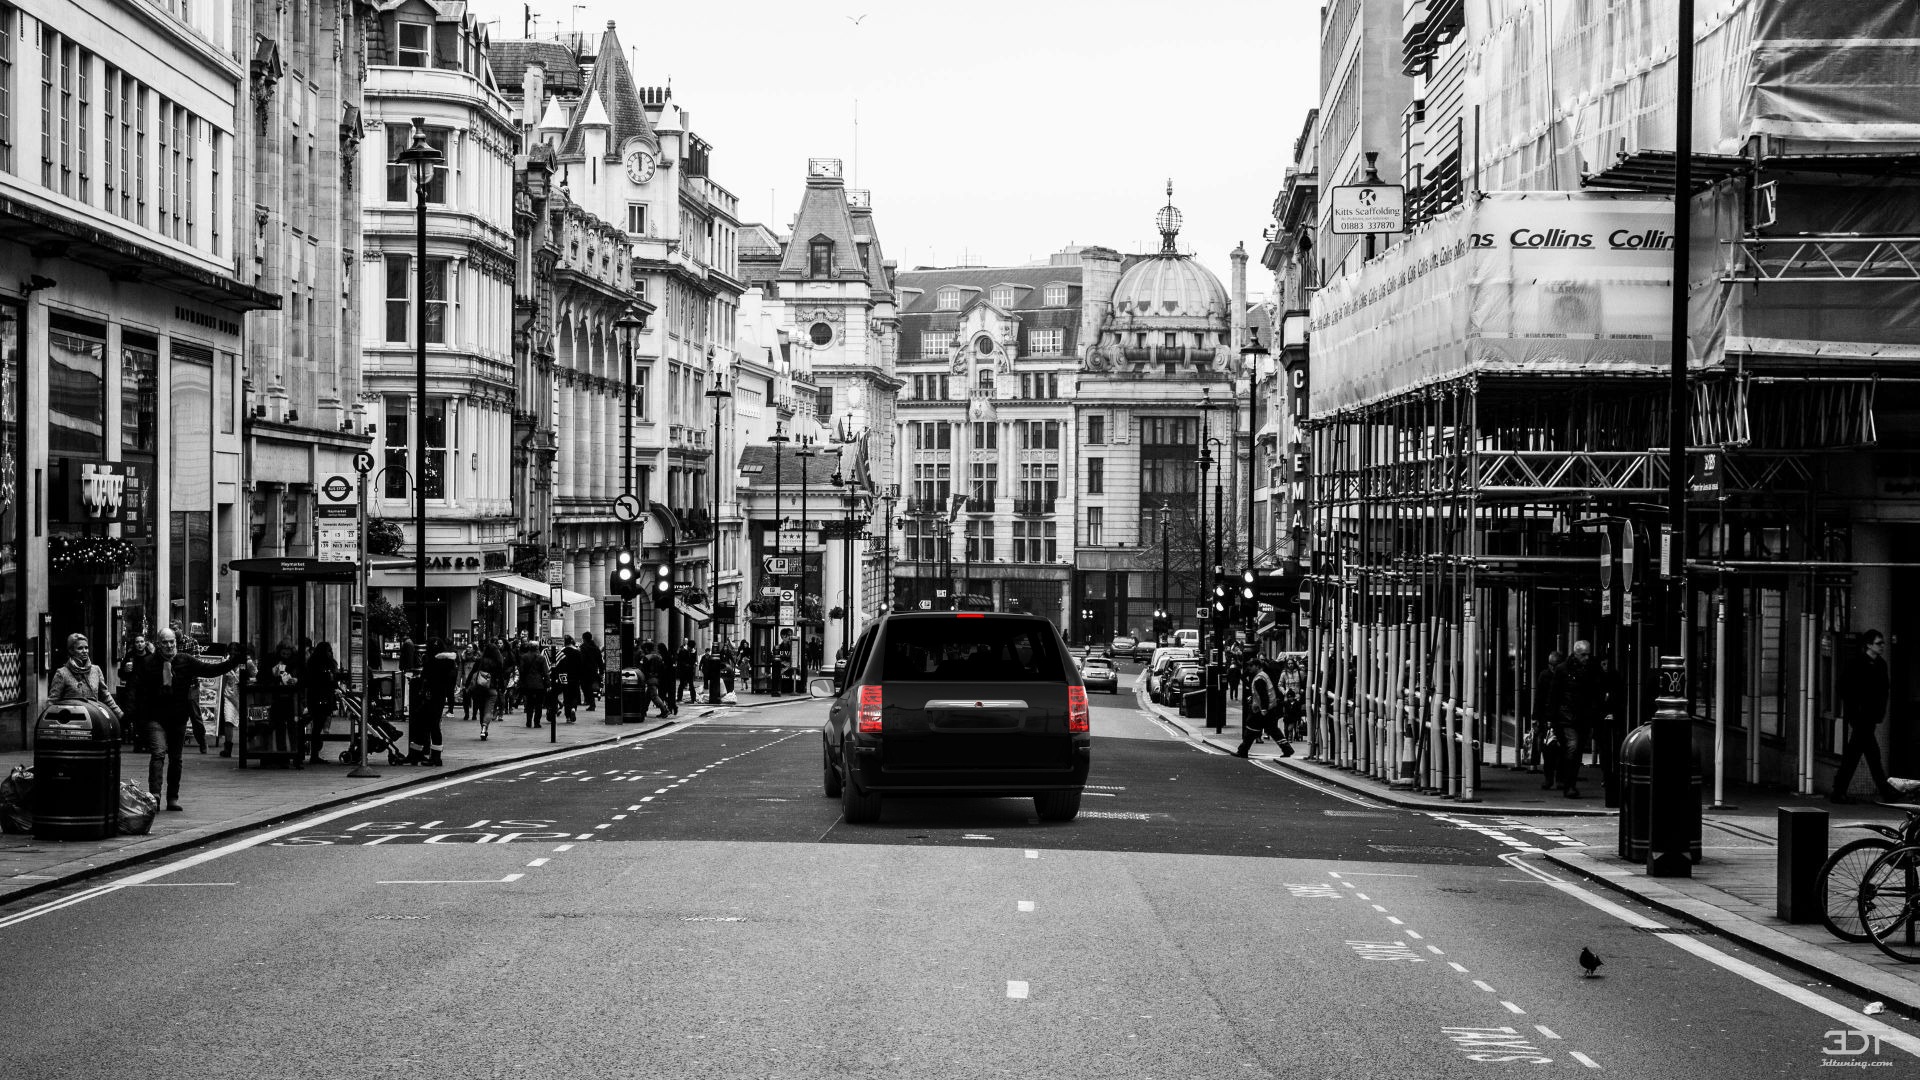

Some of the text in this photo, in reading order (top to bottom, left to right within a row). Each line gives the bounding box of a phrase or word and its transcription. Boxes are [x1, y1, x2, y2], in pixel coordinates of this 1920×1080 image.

[1335, 206, 1400, 217] Kitts Scaffolding
[1341, 221, 1395, 230] 01883 337870
[1510, 228, 1675, 249] Collins Collin
[1292, 369, 1305, 528] CINEMA
[358, 454, 370, 470] R
[455, 557, 465, 568] &
[220, 563, 228, 576] 8
[345, 820, 557, 831] BUS
[270, 832, 571, 847] STOP
